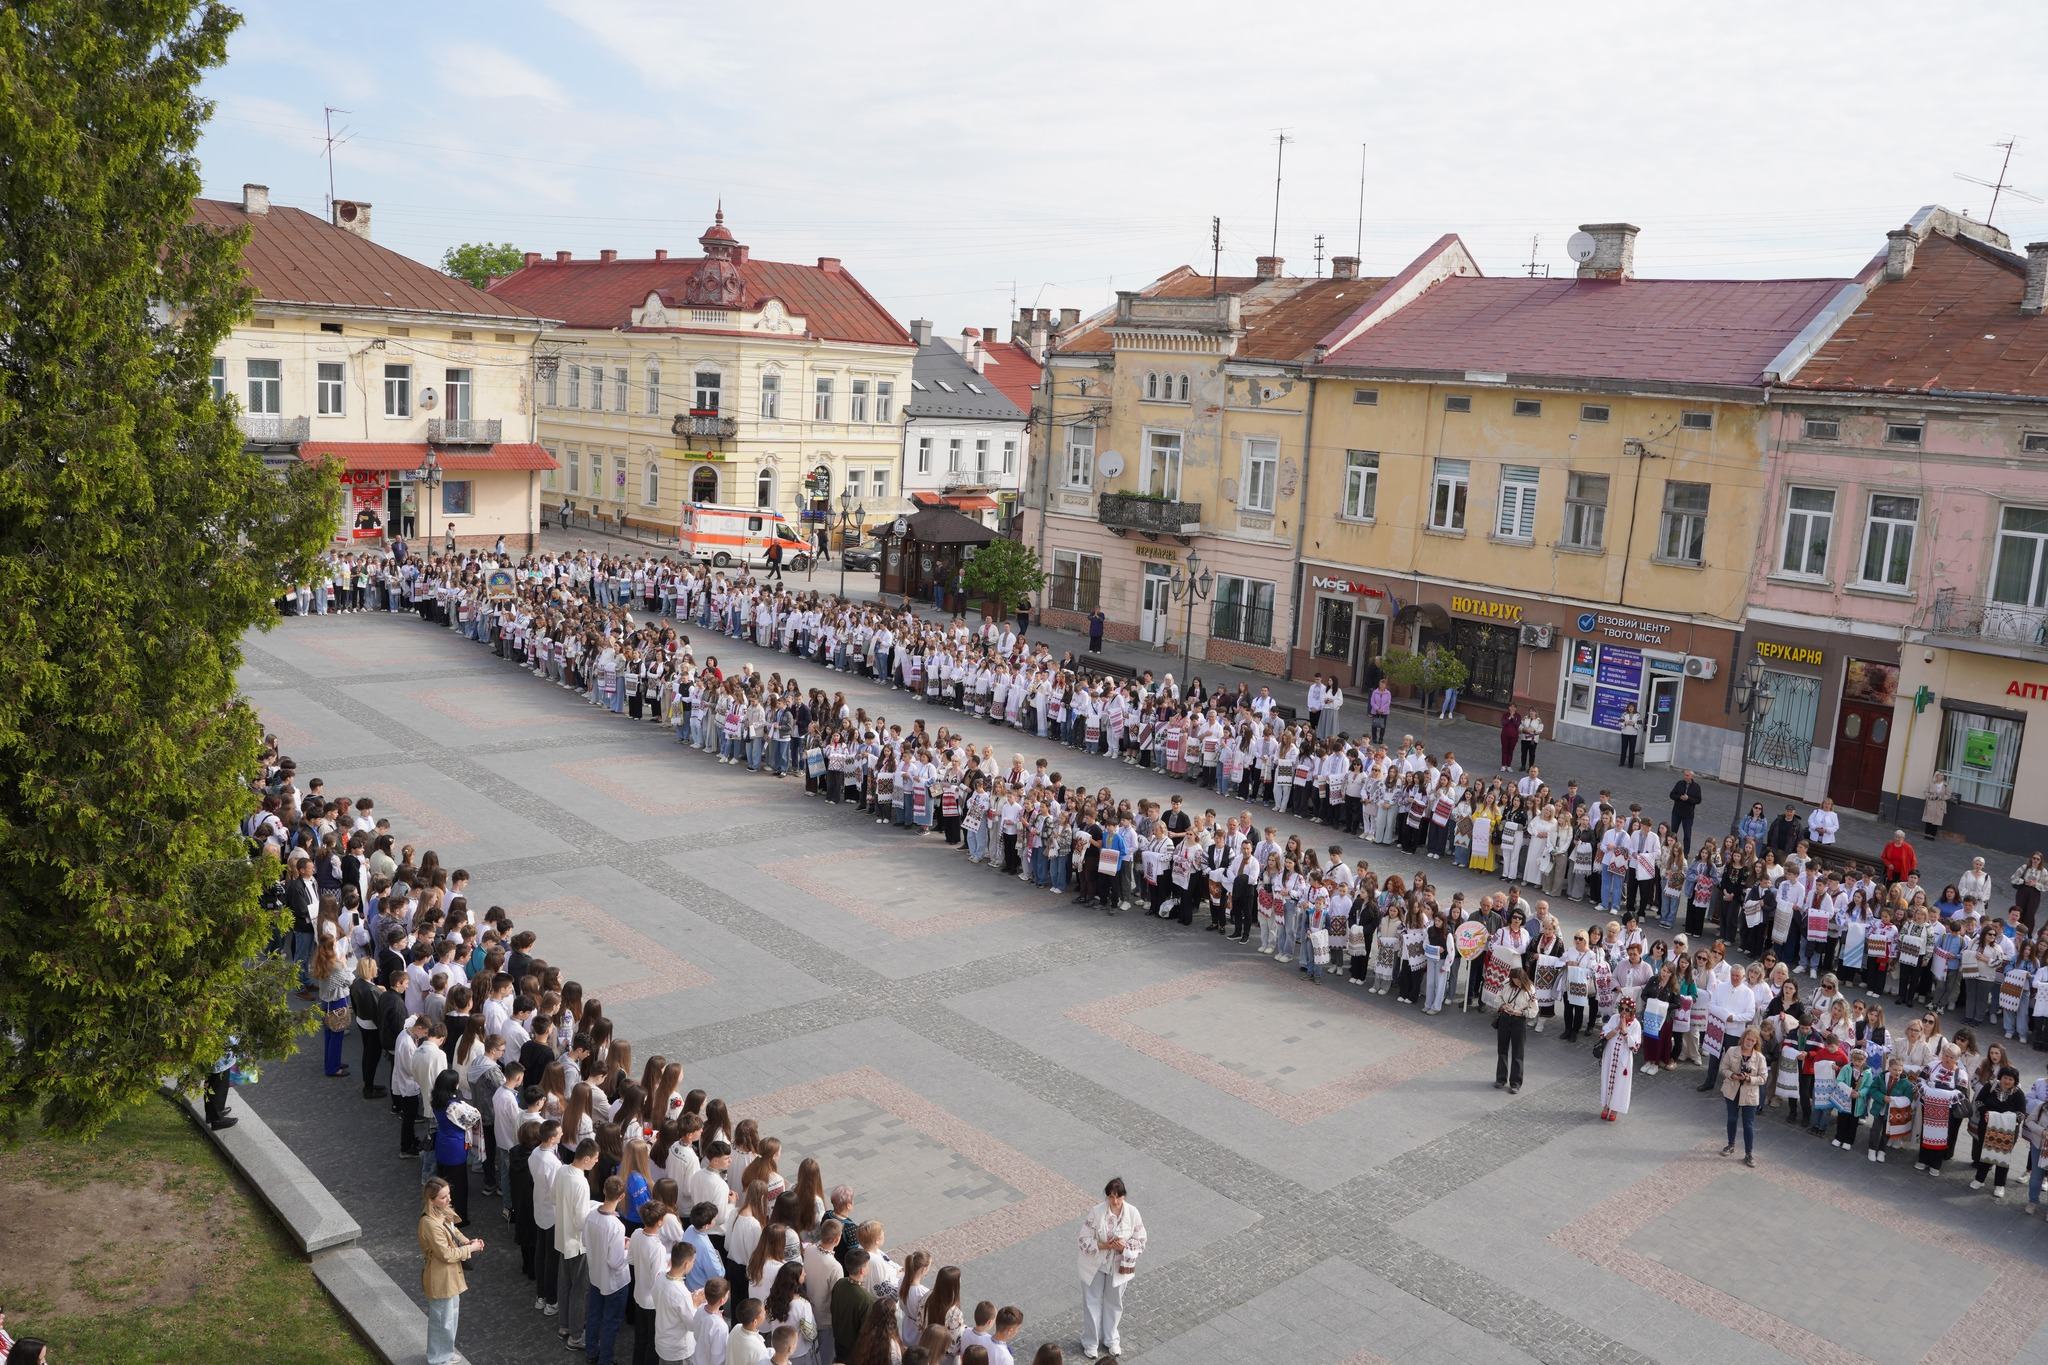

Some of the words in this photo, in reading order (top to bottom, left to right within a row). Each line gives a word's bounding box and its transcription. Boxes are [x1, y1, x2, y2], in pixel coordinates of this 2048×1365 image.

[1451, 596, 1523, 621] НОТАРІУС
[1598, 615, 1638, 629] ВІЗОВИЙ
[1640, 622, 1671, 633] ЦЕНТР
[1604, 628, 1633, 640] ТВОГО
[1635, 633, 1662, 644] МІСТА
[1757, 641, 1823, 665] ПЕРУКАРНЯ
